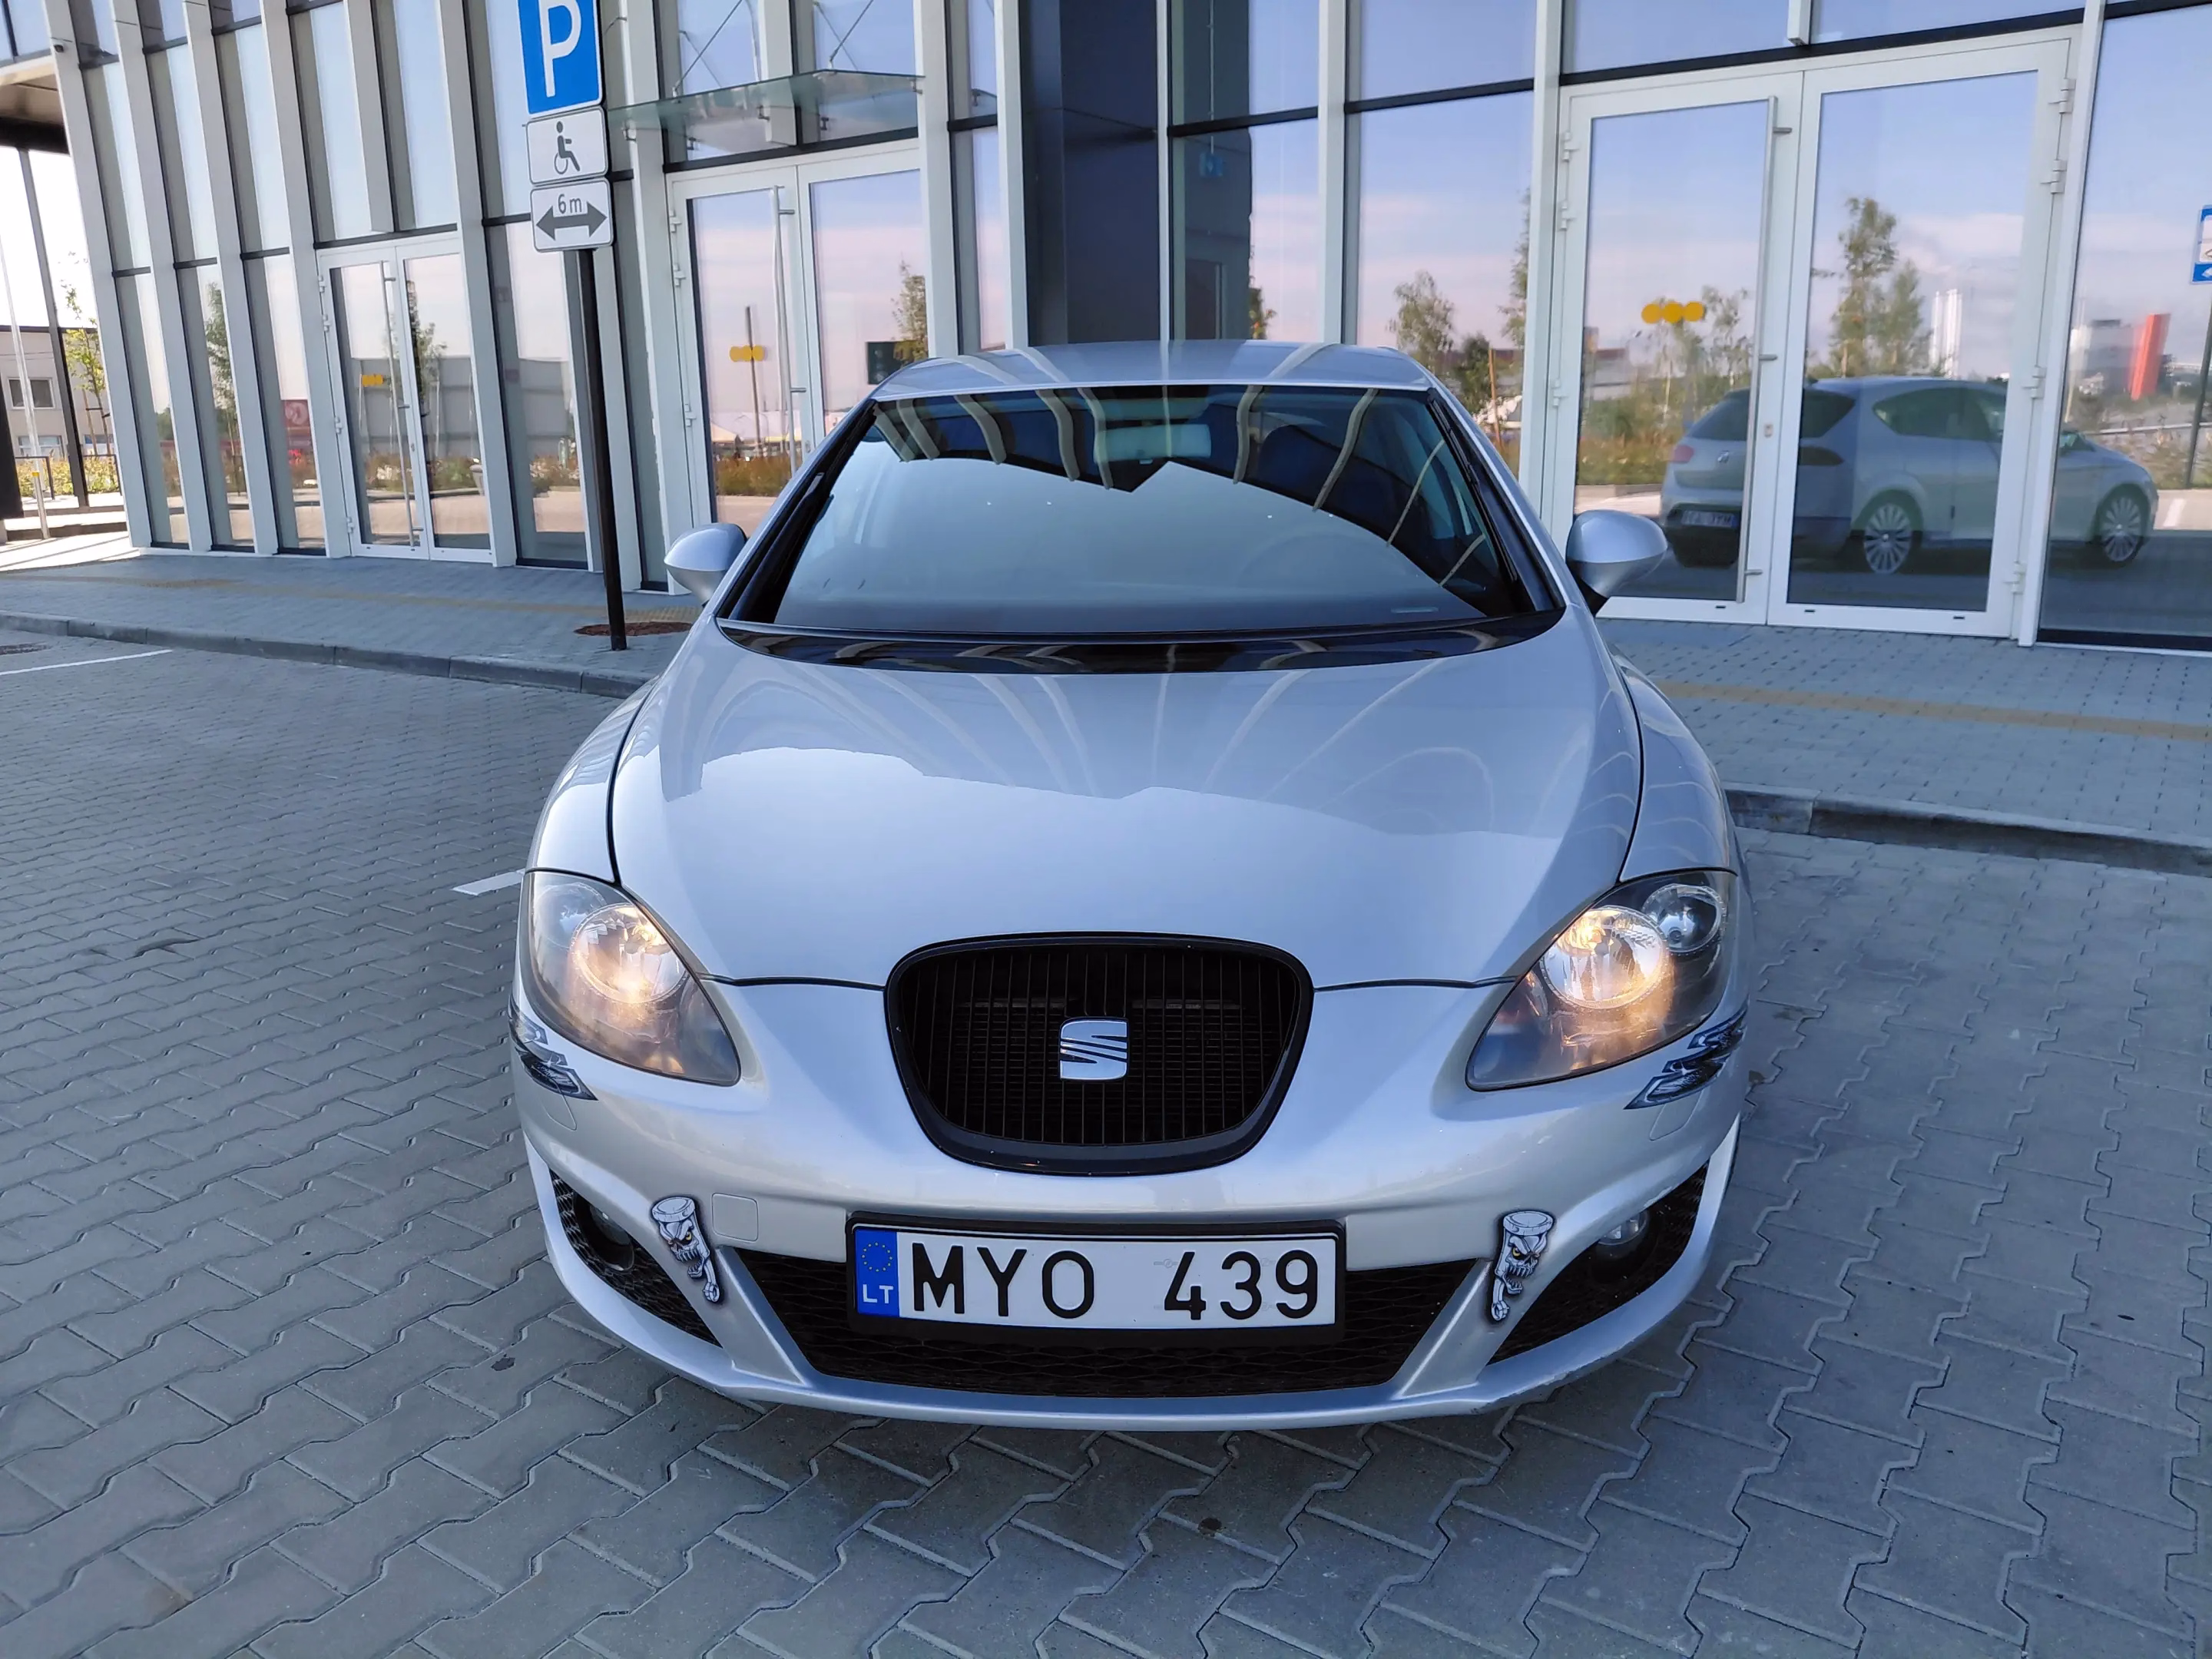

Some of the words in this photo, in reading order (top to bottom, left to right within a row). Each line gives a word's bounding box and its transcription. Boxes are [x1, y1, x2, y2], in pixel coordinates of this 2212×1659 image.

[538, 0, 581, 98] P
[863, 1283, 894, 1304] LT
[912, 1242, 1094, 1320] MYO
[1164, 1249, 1318, 1320] 439
